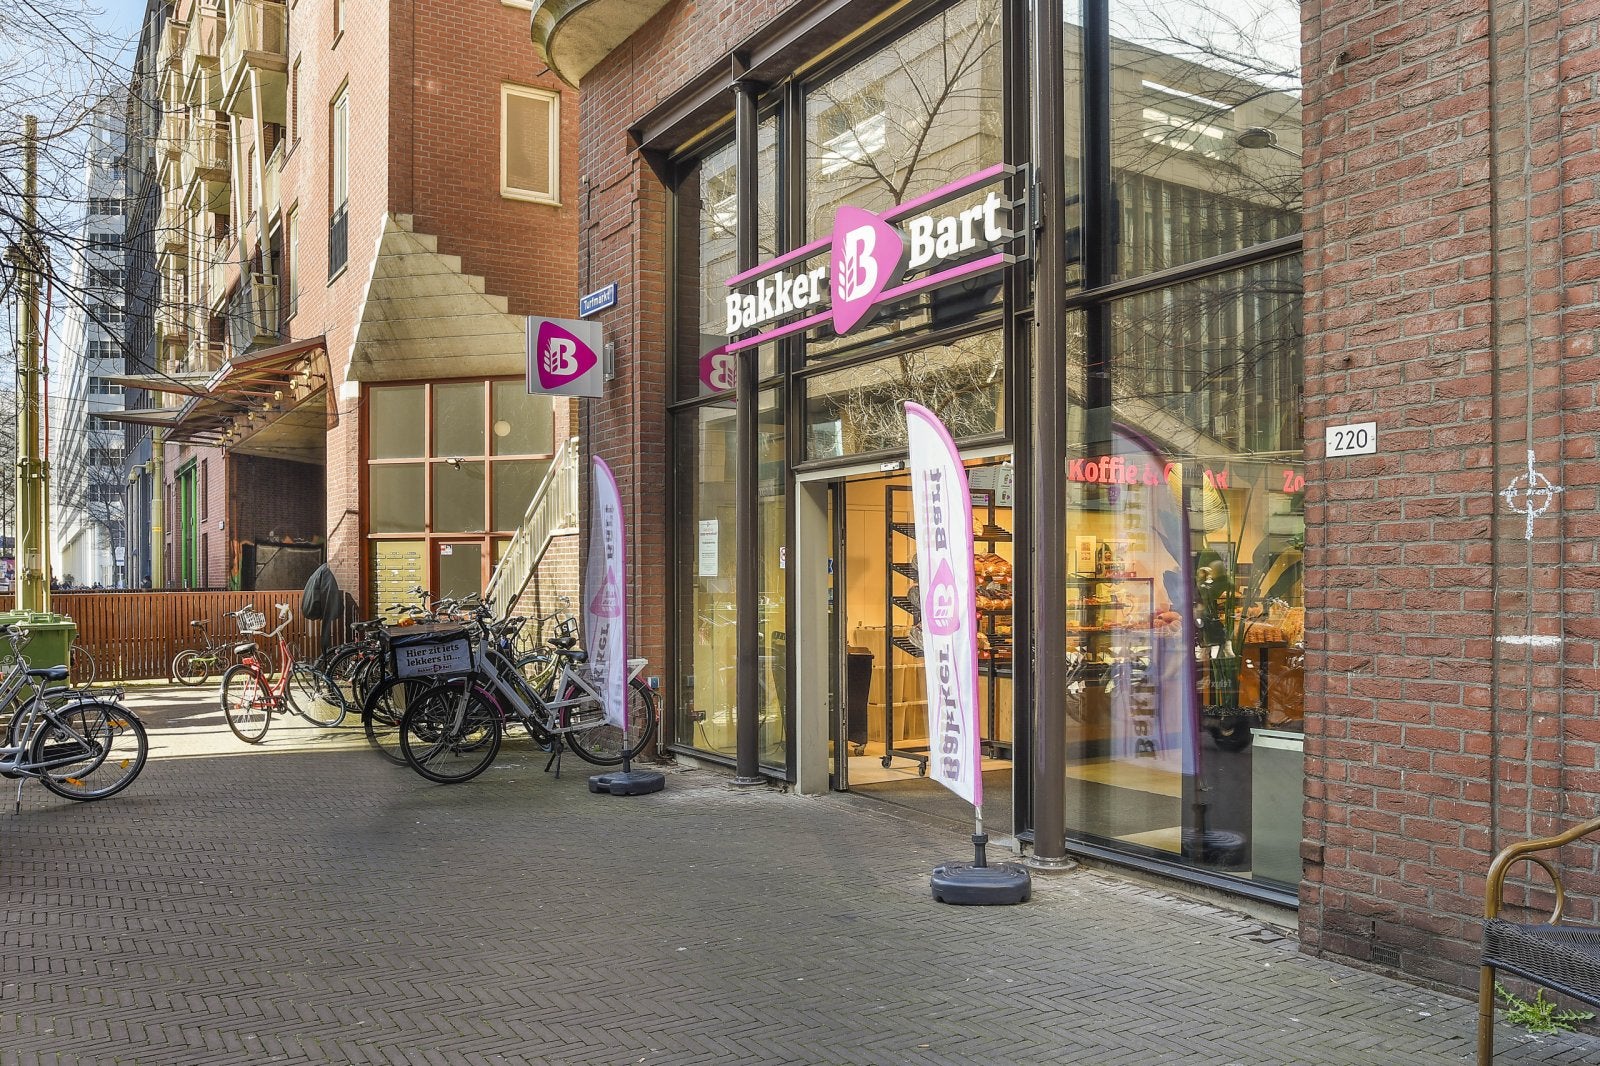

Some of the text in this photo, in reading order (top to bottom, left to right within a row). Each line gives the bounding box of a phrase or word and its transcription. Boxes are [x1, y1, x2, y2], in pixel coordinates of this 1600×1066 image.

[726, 266, 826, 335] Bakker
[909, 191, 1001, 269] Bart
[544, 337, 578, 376] B
[1335, 429, 1368, 451] 220
[1068, 456, 1138, 485] Koffie
[406, 643, 460, 658] Hier zit iets
[407, 656, 442, 667] lekkers
